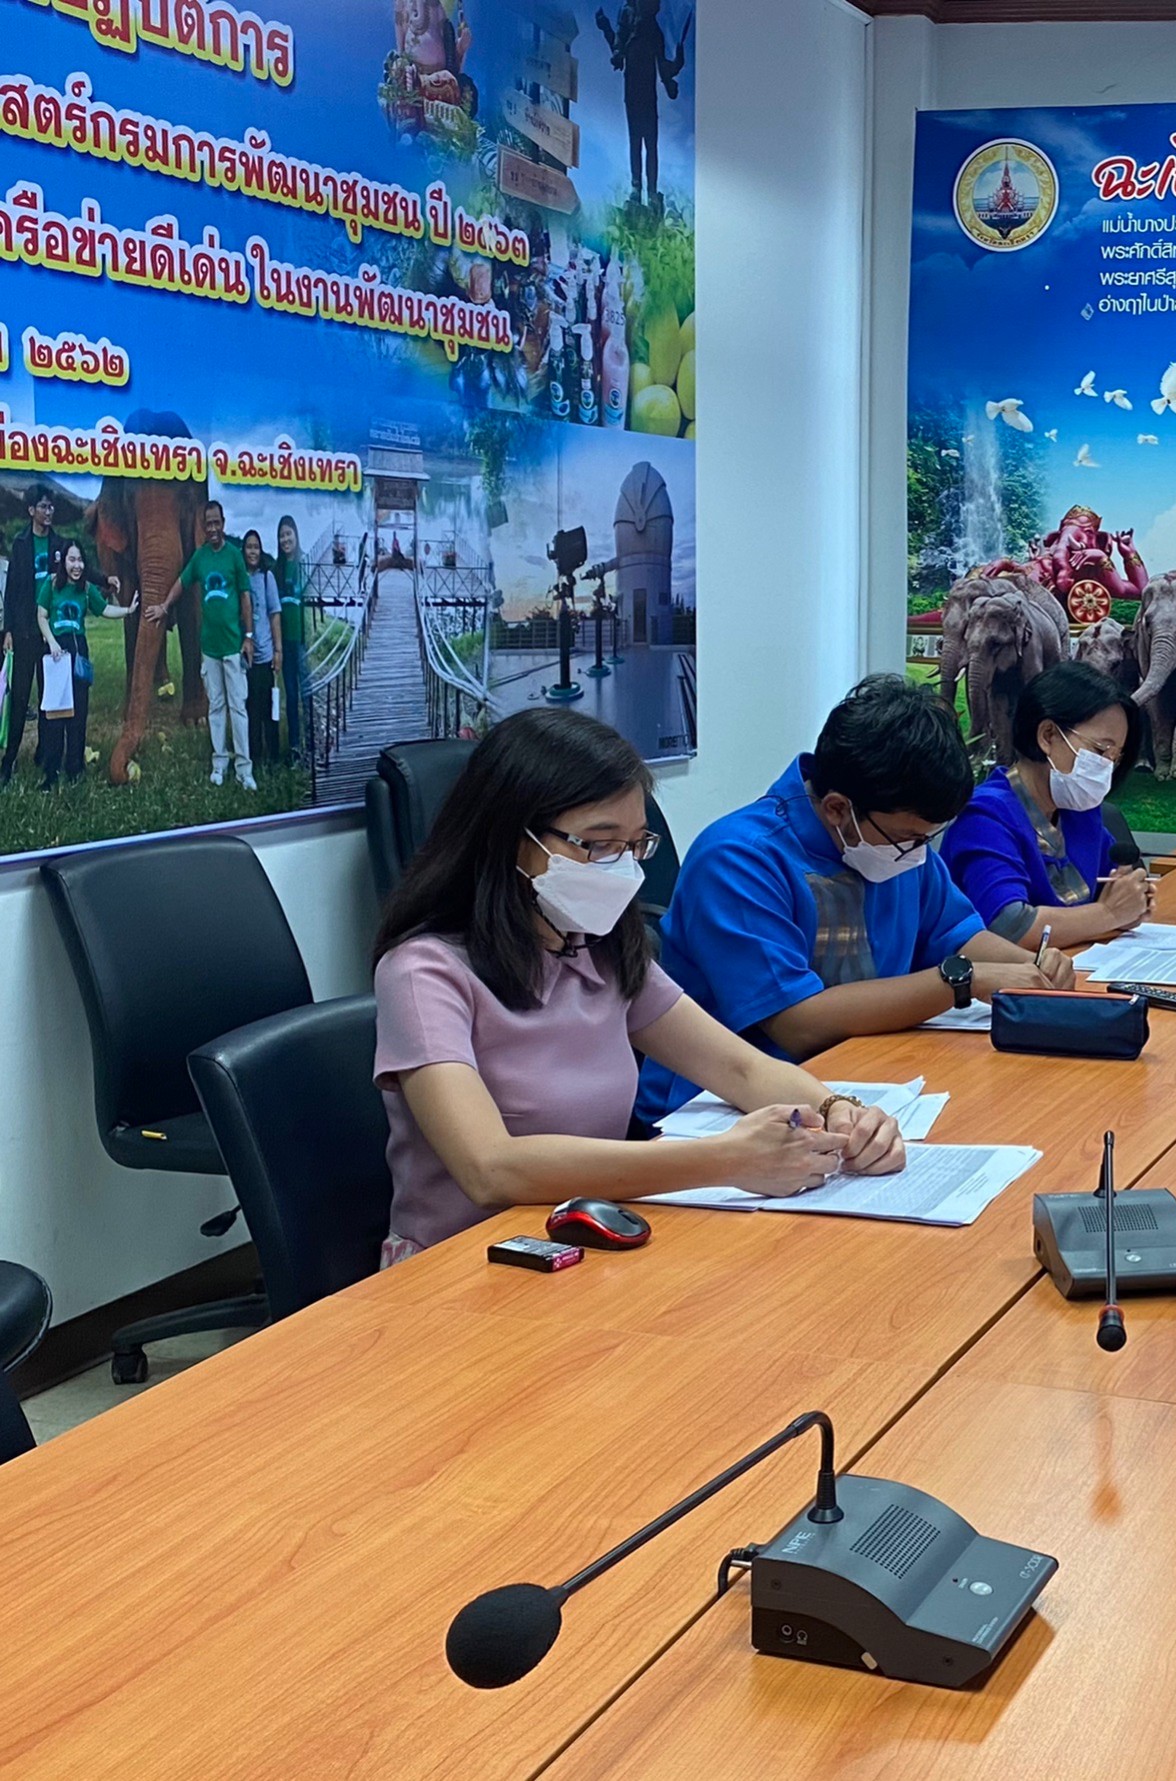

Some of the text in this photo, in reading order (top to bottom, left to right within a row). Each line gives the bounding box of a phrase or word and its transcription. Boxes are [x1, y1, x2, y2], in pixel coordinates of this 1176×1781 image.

[429, 187, 449, 241] ปี
[250, 243, 511, 355] ในงานพัฒนาชุมชน
[28, 335, 125, 379] ๒๕๖๒
[0, 410, 360, 487] องฉะเชิงเทรา จ.ฉะเชิงเทรา
[781, 1531, 813, 1554] NPE
